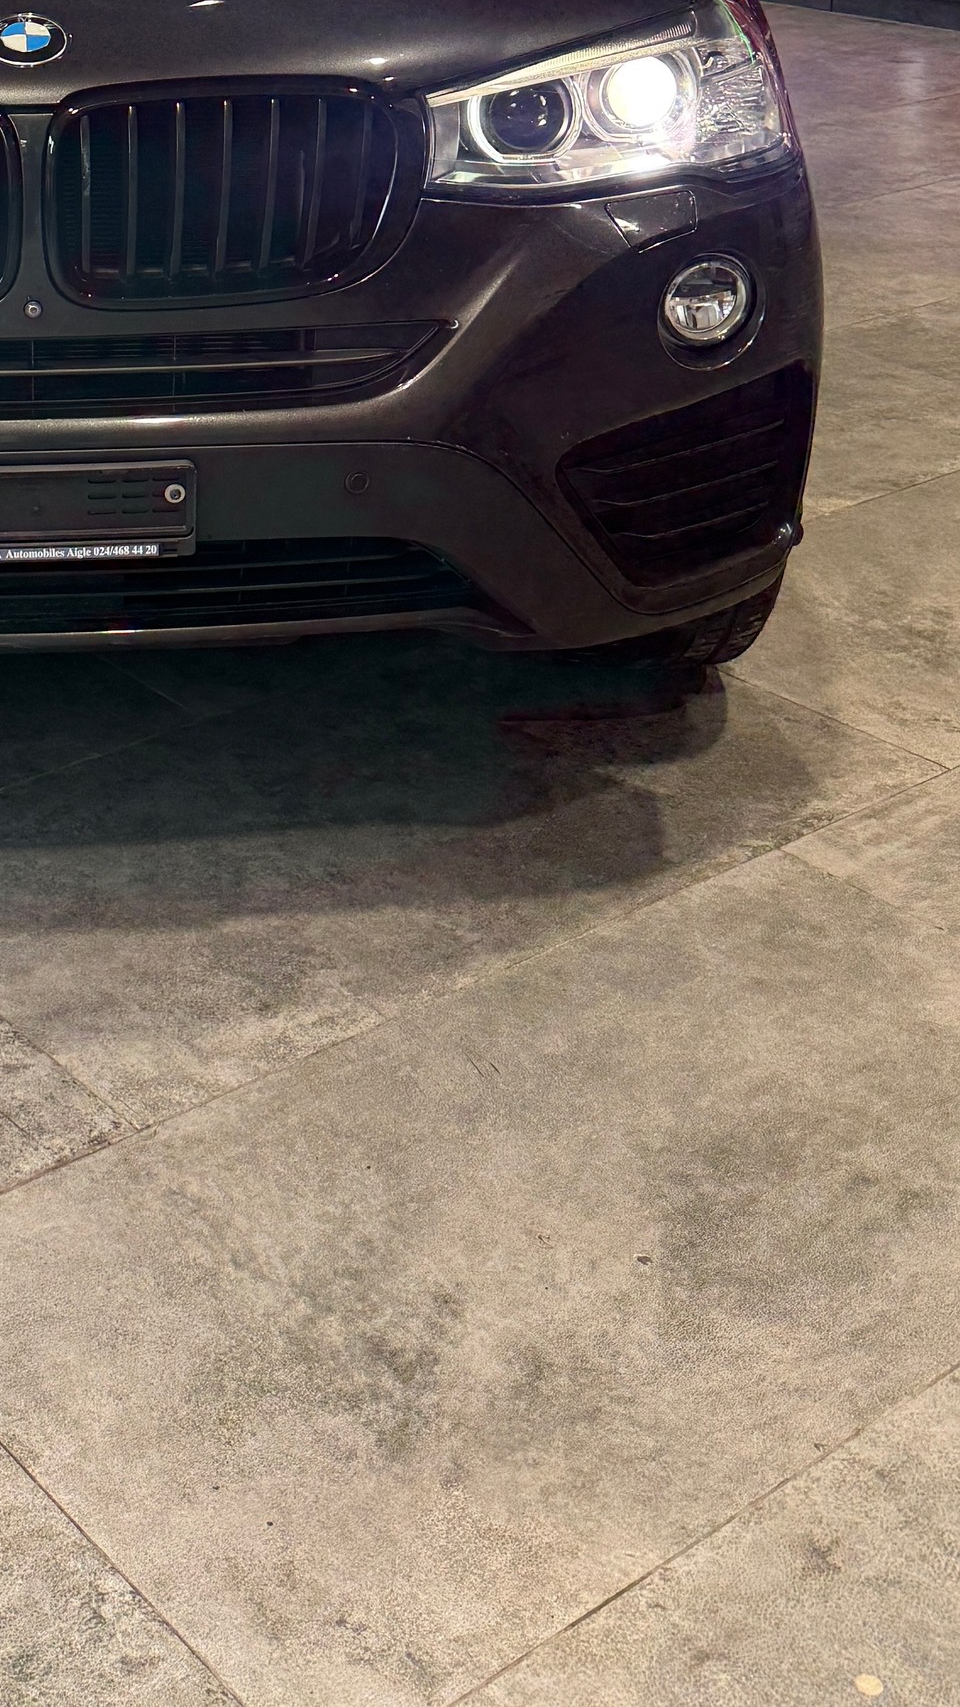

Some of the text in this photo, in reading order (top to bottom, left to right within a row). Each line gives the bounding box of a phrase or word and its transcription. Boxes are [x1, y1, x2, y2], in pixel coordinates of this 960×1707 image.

[5, 547, 65, 559] Automobiles
[66, 547, 92, 559] Aigle
[93, 545, 130, 557] 024/468
[131, 545, 143, 555] 44
[145, 544, 157, 555] 20
